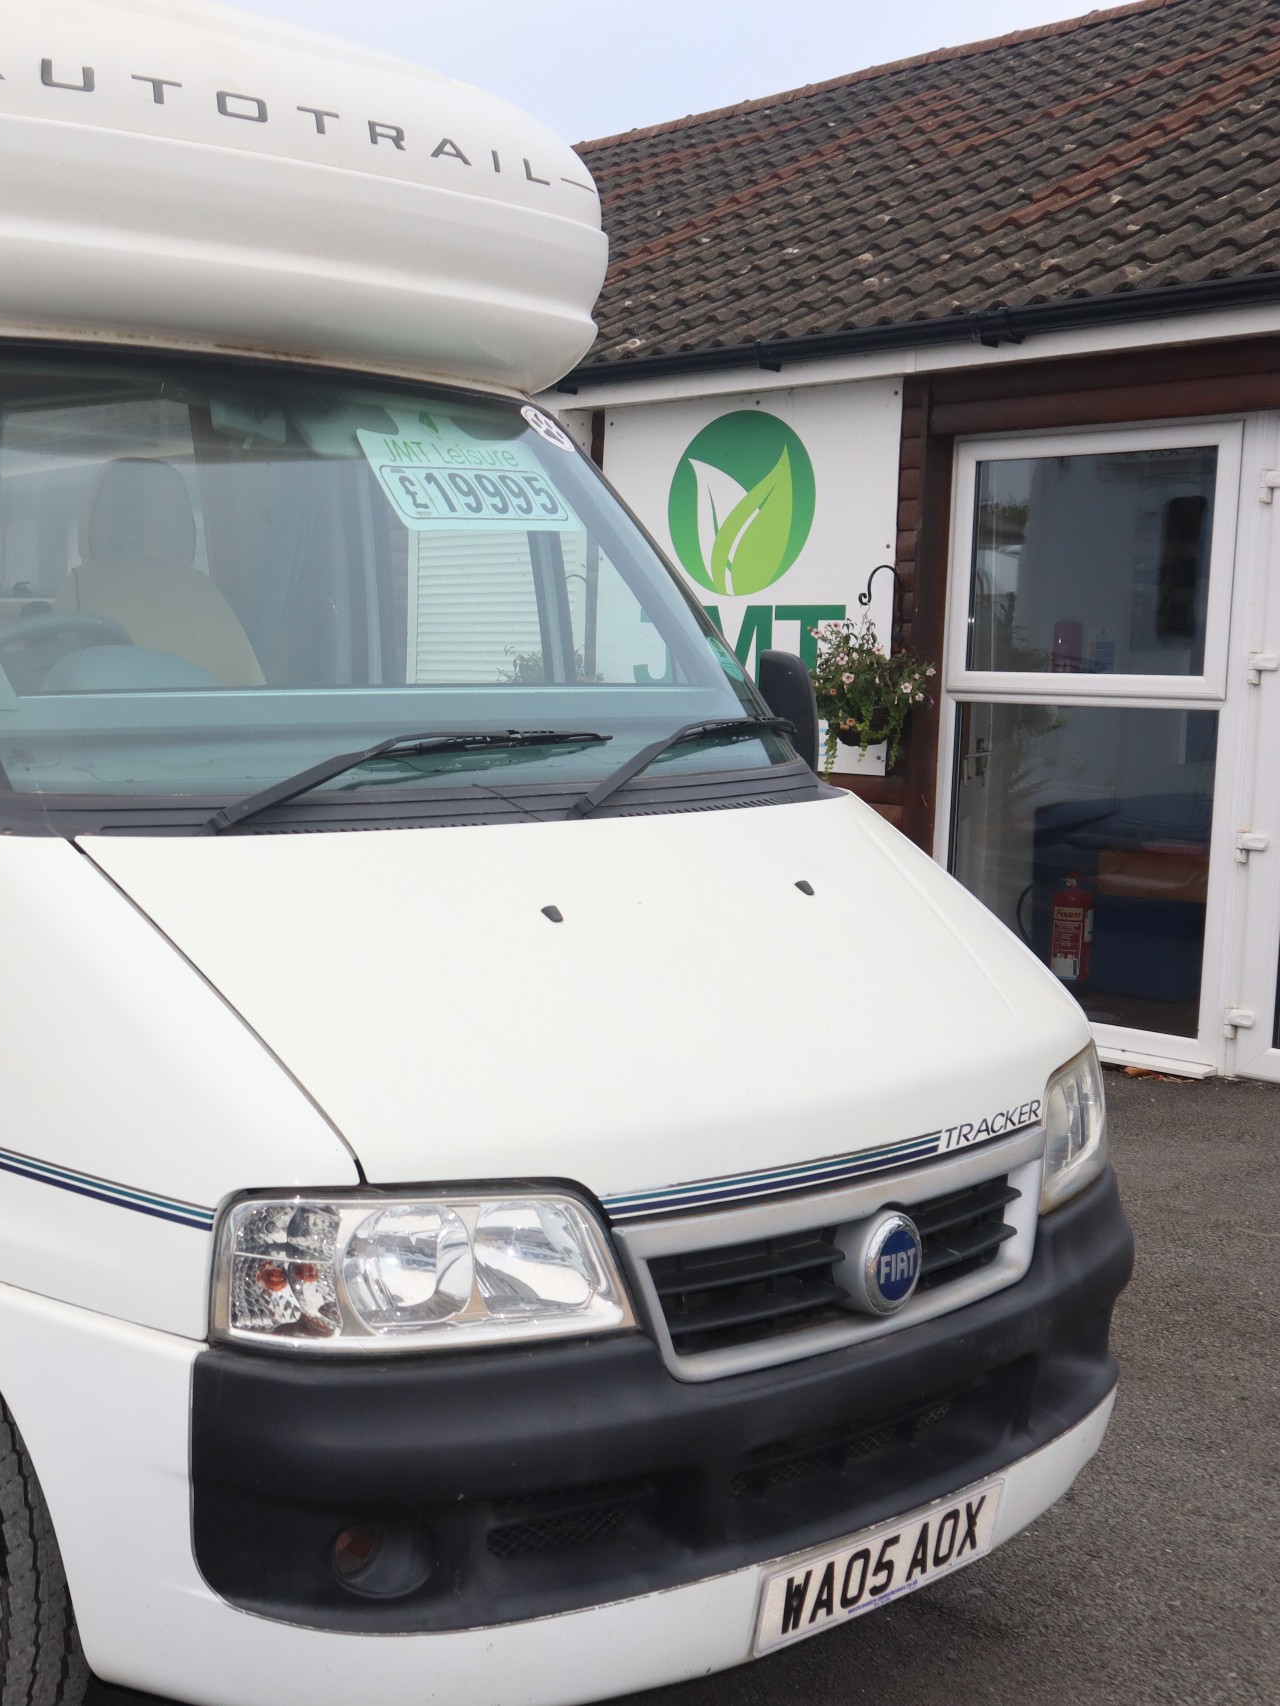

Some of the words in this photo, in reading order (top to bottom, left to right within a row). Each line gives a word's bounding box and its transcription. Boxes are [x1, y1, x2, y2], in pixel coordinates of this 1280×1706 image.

[382, 437, 432, 464] JMT
[430, 441, 520, 468] Leisure
[398, 472, 559, 515] £19995
[944, 1098, 1041, 1149] TRACKER
[879, 1248, 916, 1285] FIAT
[781, 1534, 901, 1635] WA05
[905, 1495, 987, 1583] AOX
